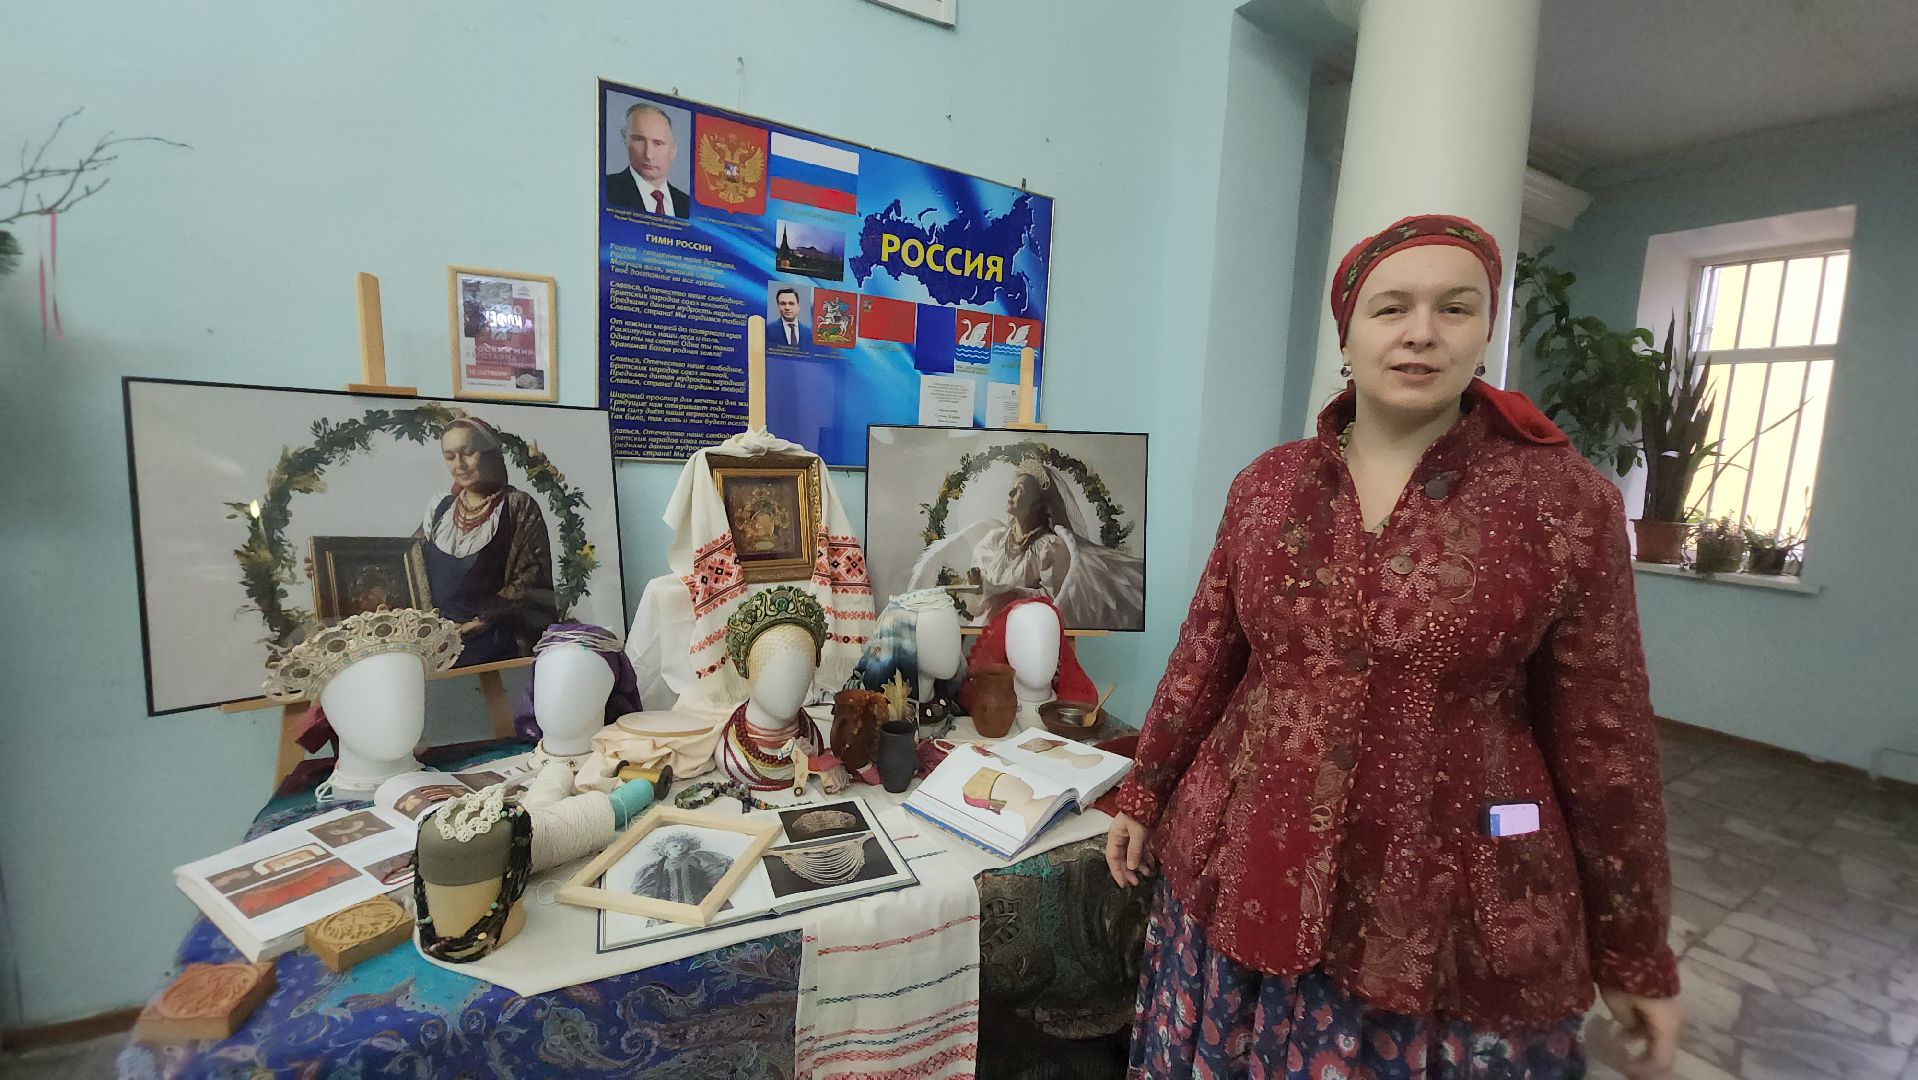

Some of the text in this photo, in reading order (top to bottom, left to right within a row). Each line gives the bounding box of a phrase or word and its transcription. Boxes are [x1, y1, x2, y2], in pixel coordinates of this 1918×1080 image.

[646, 234, 712, 252] ГИМН РОССИИ
[881, 234, 1004, 282] РОССИЯ
[610, 288, 648, 299] Братских
[674, 311, 686, 319] Мы
[610, 318, 623, 326] От
[624, 320, 652, 328] южных
[678, 324, 688, 332] до
[610, 332, 630, 340] Одна
[681, 340, 700, 348] Одна
[676, 376, 712, 384] мудрость
[610, 390, 644, 400] Широкий
[646, 394, 678, 403] простор
